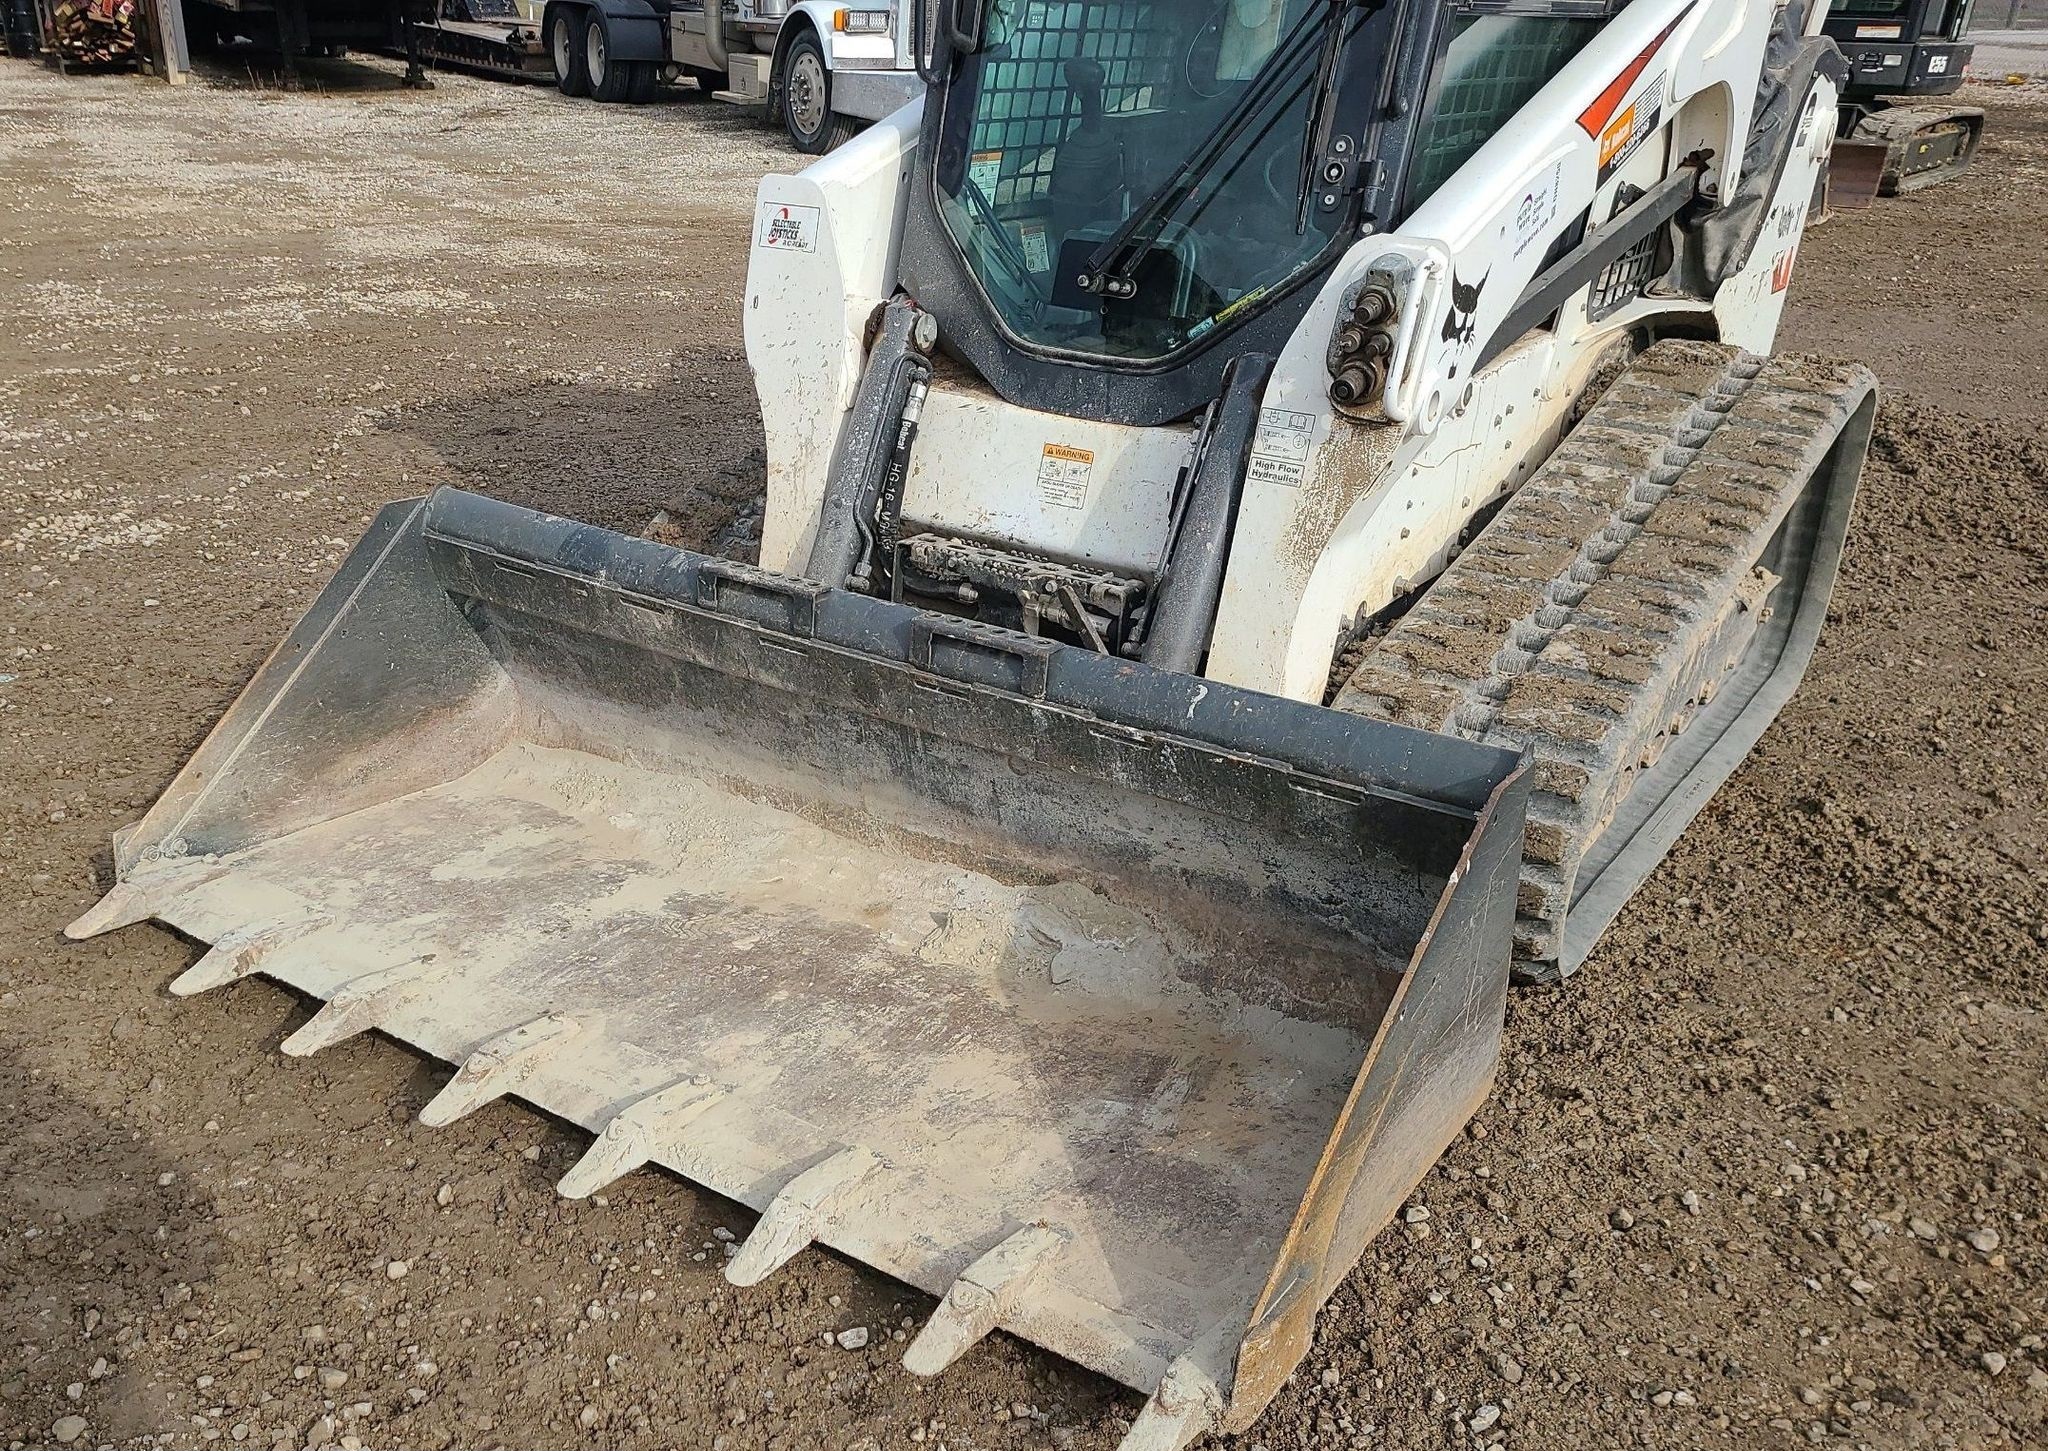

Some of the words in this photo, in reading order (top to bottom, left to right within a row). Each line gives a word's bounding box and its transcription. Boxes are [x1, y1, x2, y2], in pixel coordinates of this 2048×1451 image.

[1928, 55, 1948, 73] E55
[768, 228, 799, 240] JOYSTICKS
[897, 420, 912, 450] Bobcat
[1055, 447, 1090, 461] WARNING
[1255, 460, 1276, 470] High
[1278, 464, 1300, 474] Flow
[1252, 469, 1298, 484] Hydraulics
